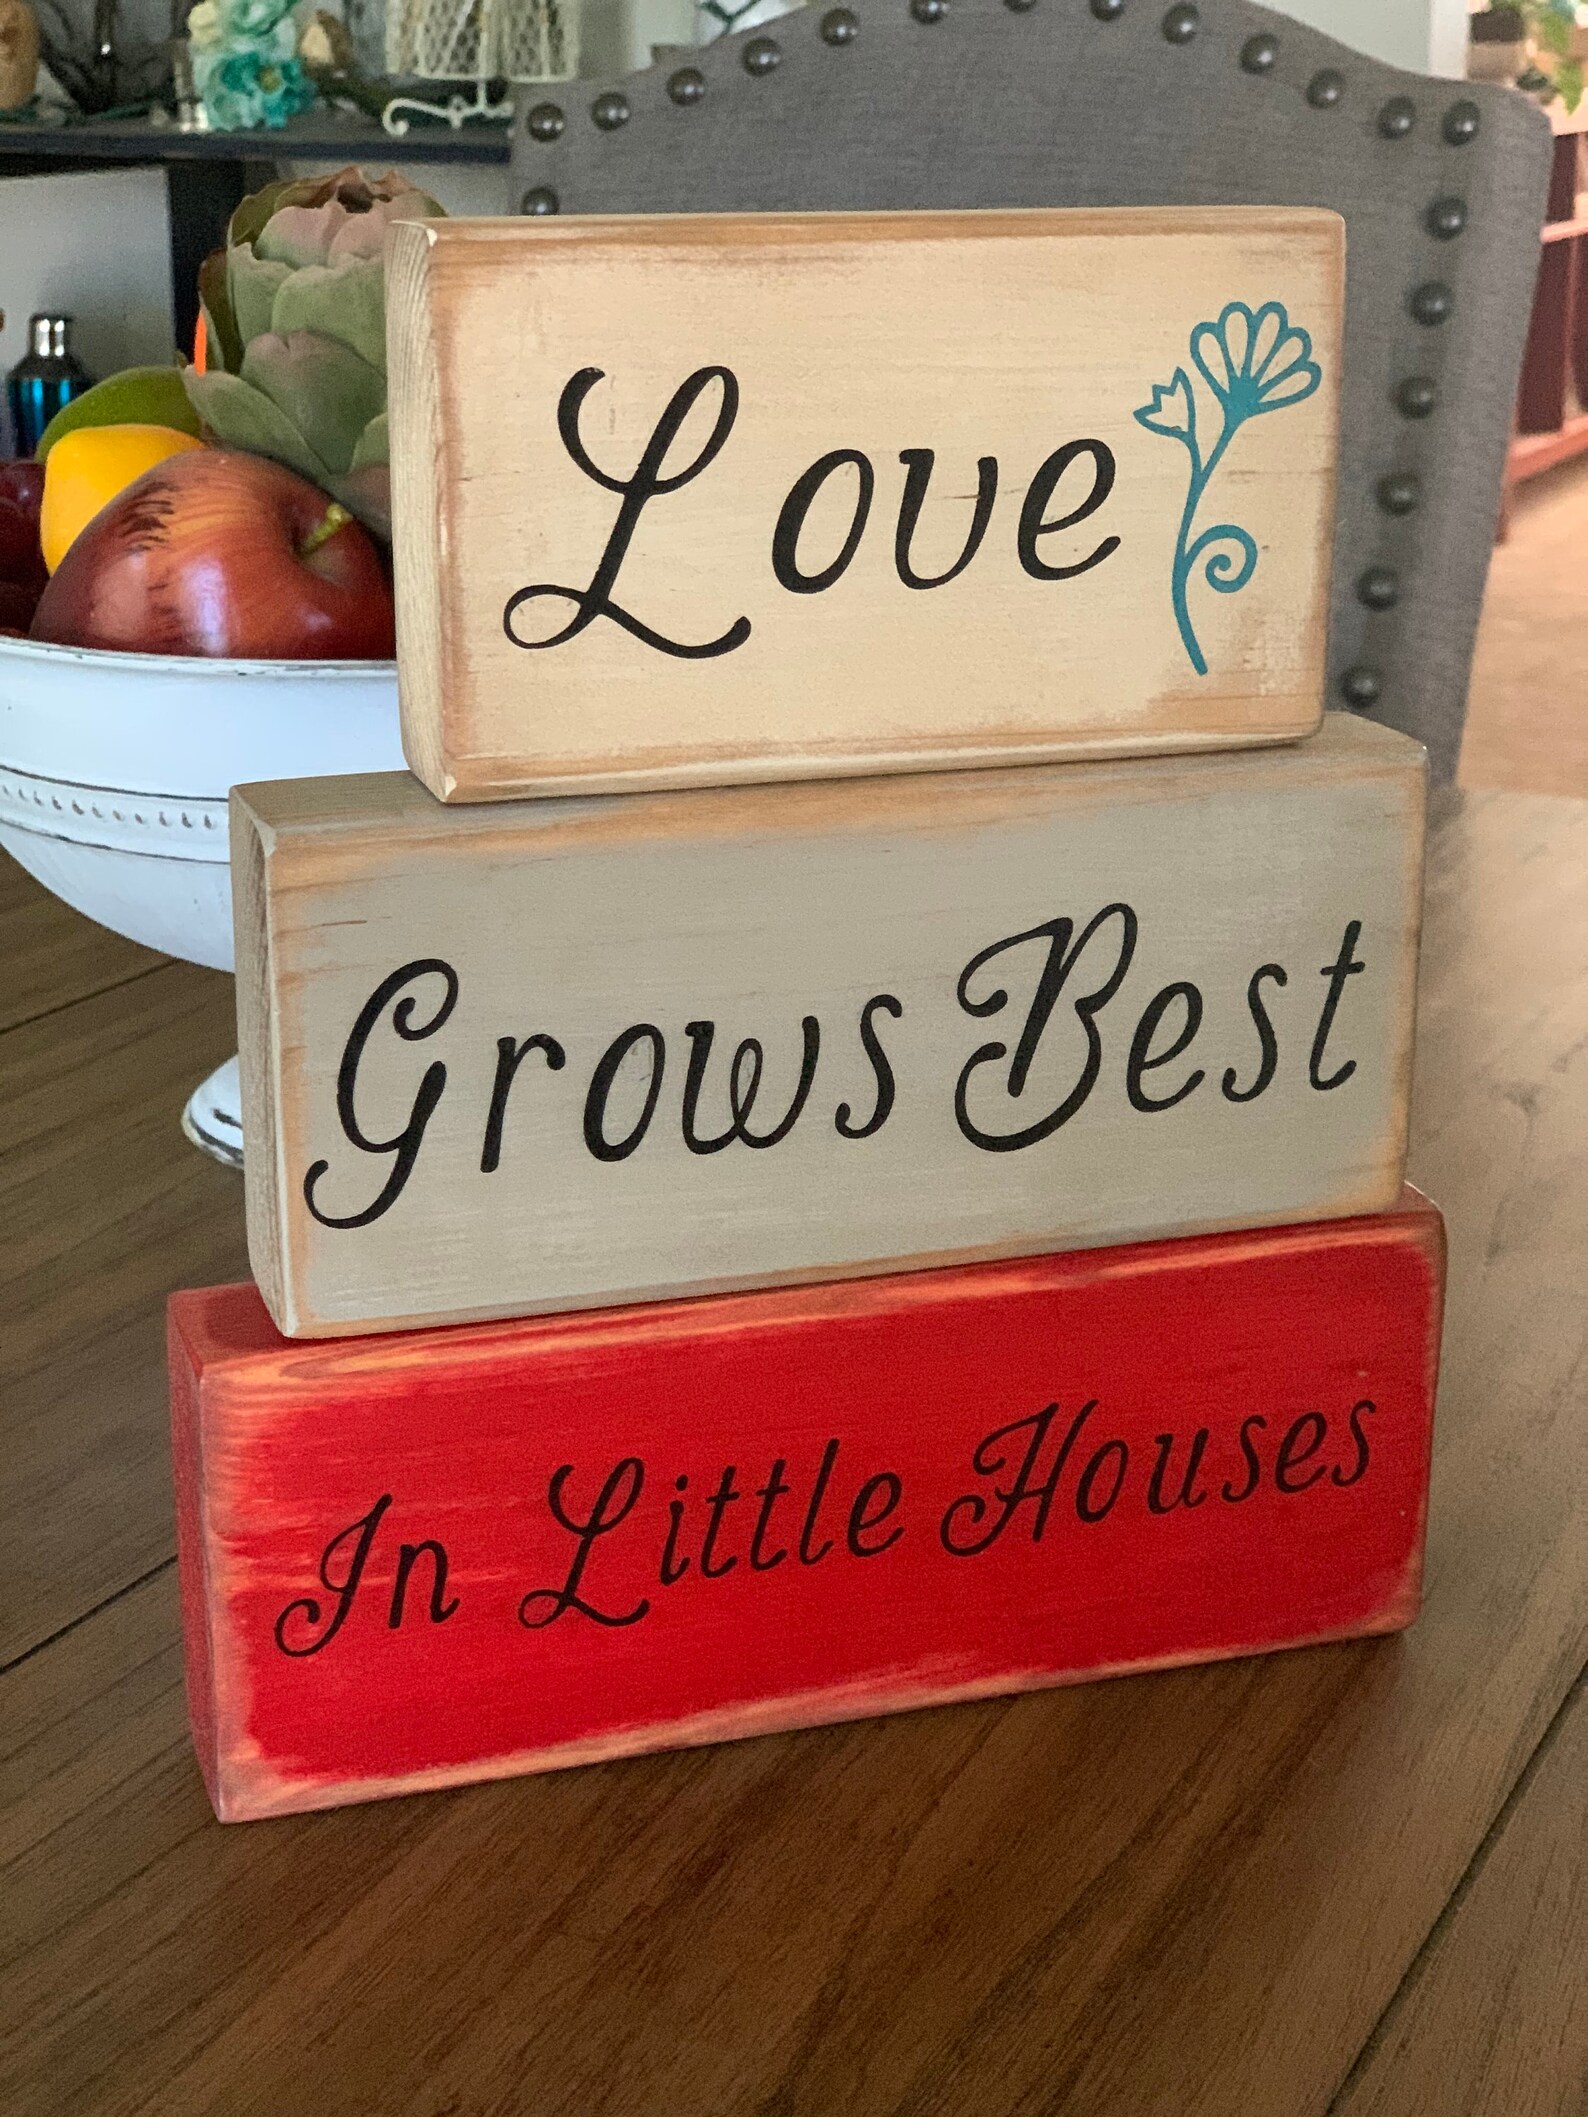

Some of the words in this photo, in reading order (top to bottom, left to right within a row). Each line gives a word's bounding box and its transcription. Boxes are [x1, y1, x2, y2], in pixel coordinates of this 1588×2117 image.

[504, 365, 1121, 659] Love
[303, 958, 903, 1230] Grows
[954, 902, 1366, 1153] Best
[275, 1494, 459, 1657] In
[519, 1439, 904, 1629] Little
[940, 1399, 1377, 1557] Houses
